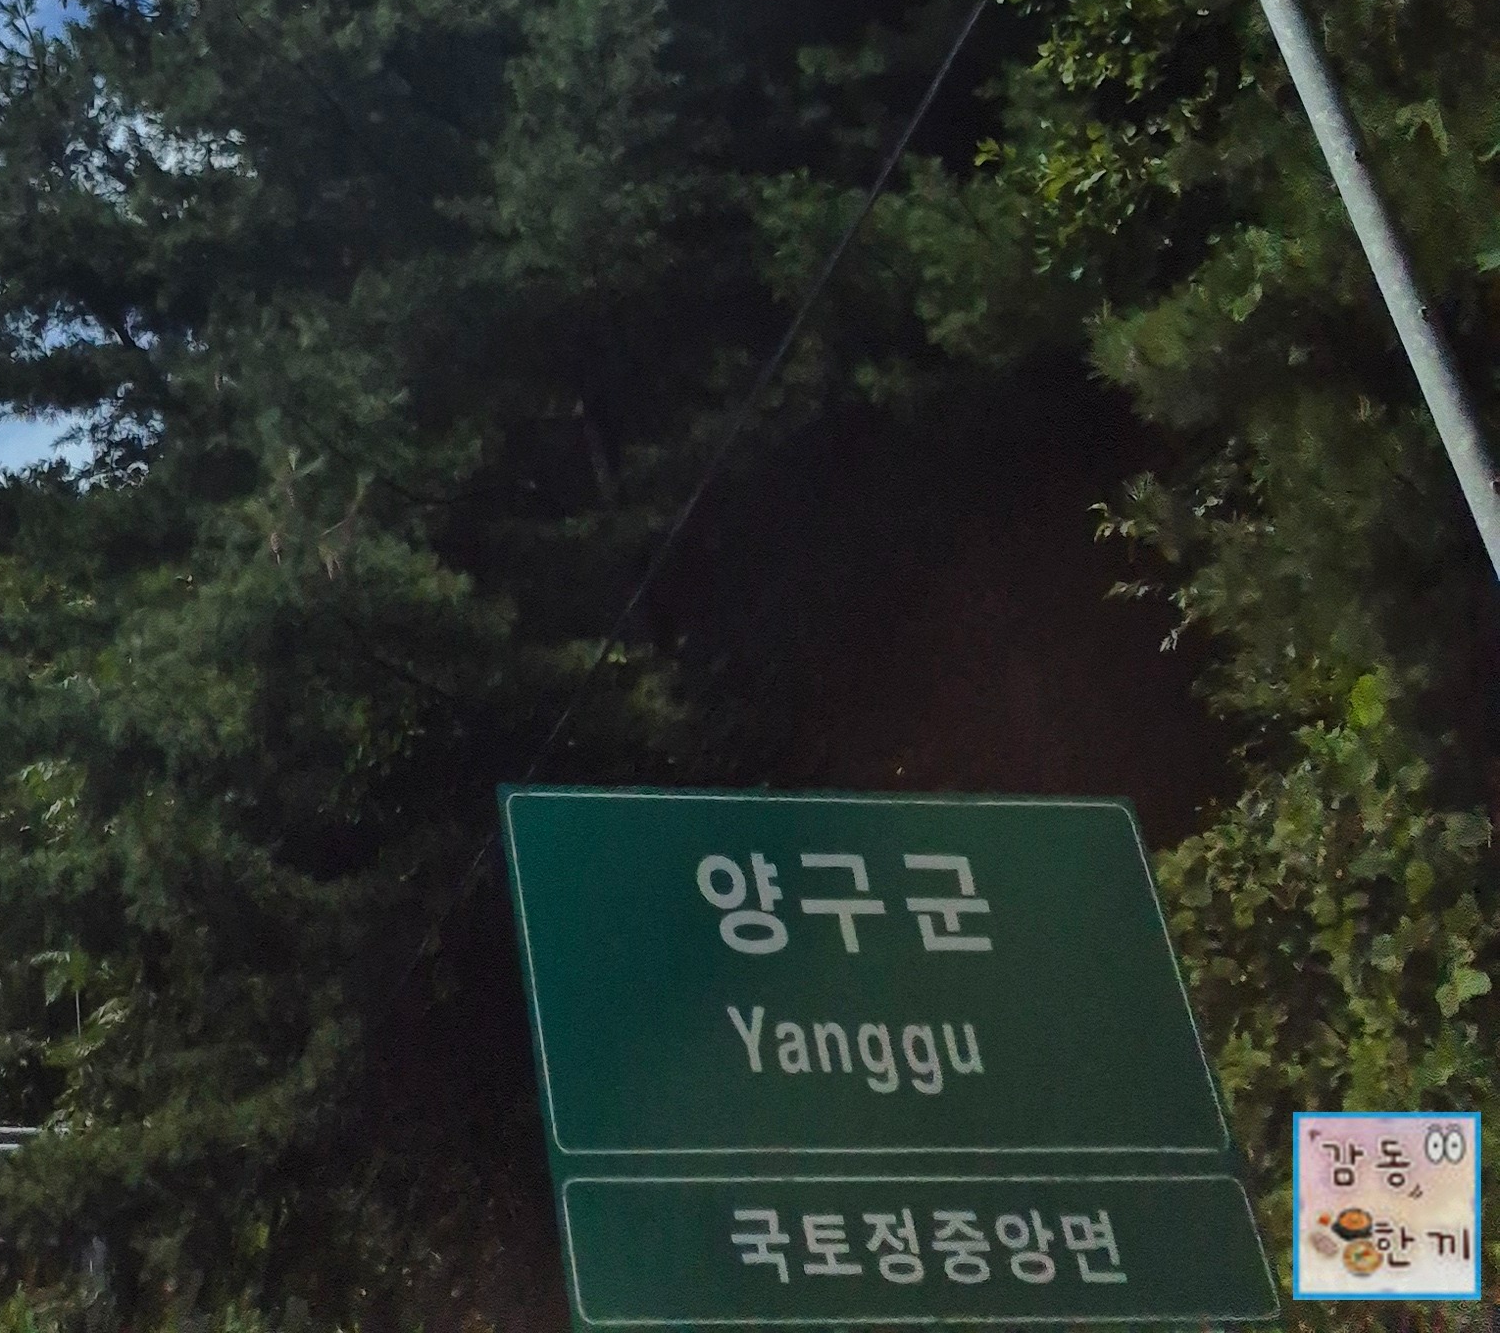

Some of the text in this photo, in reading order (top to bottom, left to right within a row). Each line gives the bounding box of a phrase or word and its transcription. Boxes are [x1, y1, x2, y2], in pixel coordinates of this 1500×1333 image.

[696, 852, 994, 955] 양구군
[726, 1005, 984, 1095] Yanggu
[730, 1208, 1128, 1284] 국토정중앙면
